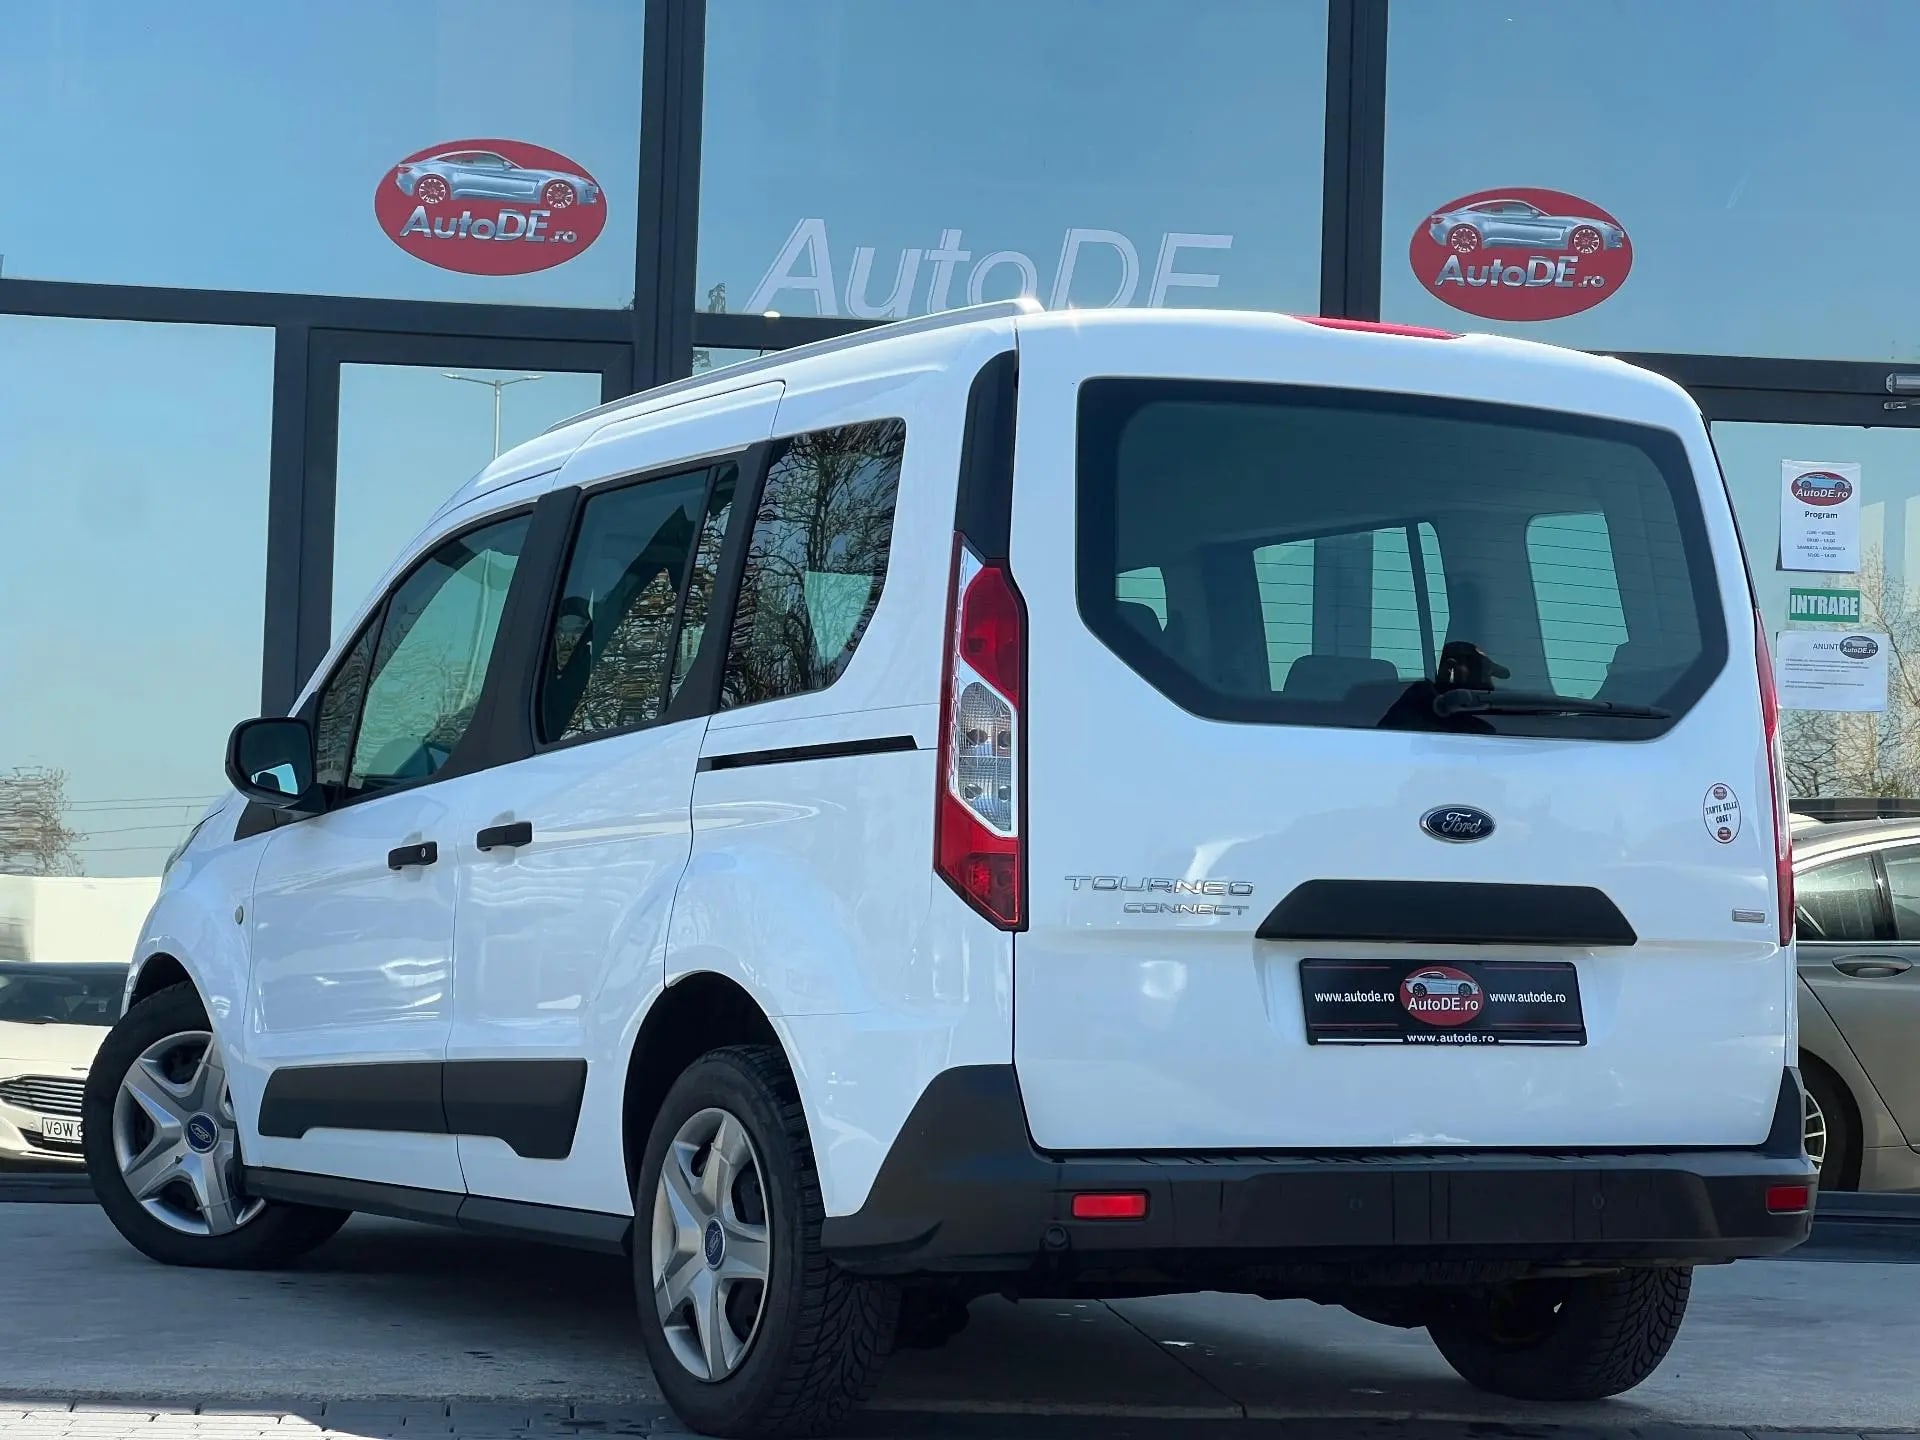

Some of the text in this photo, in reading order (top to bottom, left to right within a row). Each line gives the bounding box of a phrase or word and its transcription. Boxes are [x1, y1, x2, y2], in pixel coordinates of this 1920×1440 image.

[1796, 488, 1848, 498] AutoDE.ro
[1804, 510, 1838, 519] Program
[1791, 594, 1858, 616] INTRARE
[1441, 812, 1482, 836] Ford
[1064, 875, 1254, 896] TOURNEO
[1123, 902, 1249, 916] CONNECT
[1314, 989, 1395, 1002] www.autode.ro
[1489, 991, 1566, 1003] www.autode.ro
[1408, 997, 1479, 1011] AutoDE.ro
[1407, 1033, 1495, 1043] www.autode.ro
